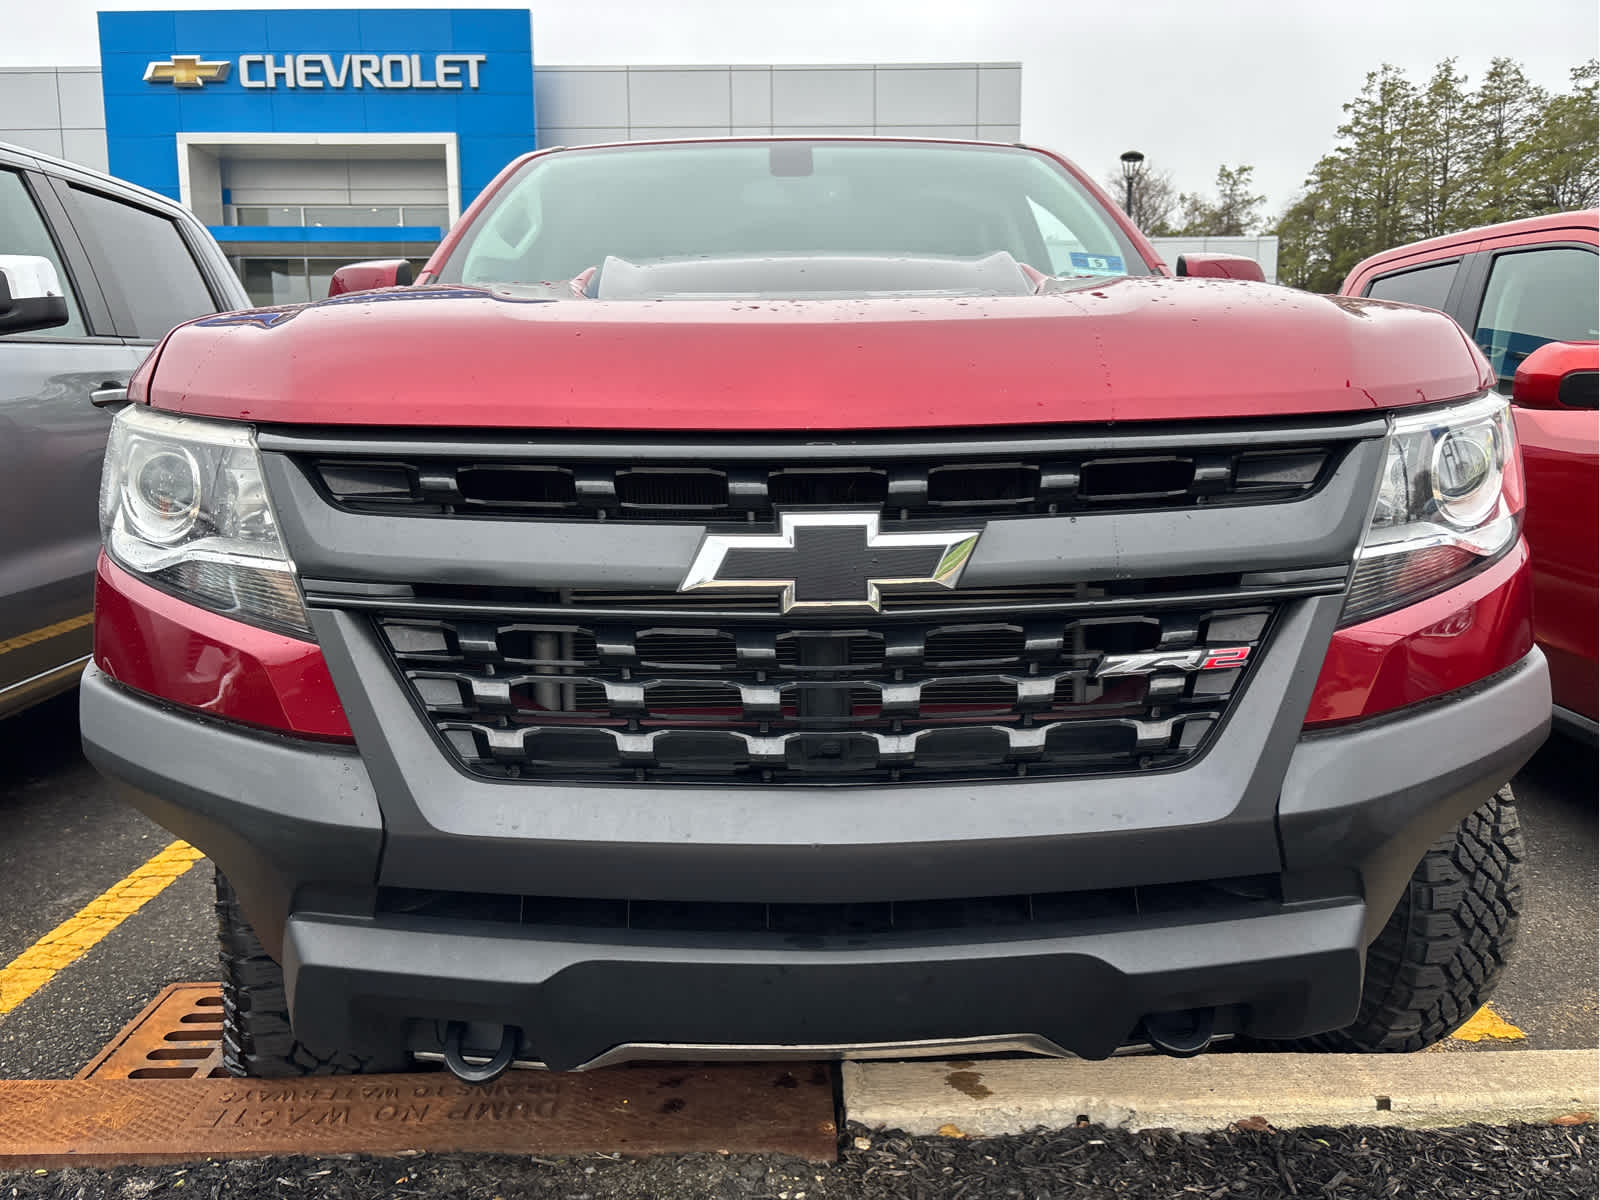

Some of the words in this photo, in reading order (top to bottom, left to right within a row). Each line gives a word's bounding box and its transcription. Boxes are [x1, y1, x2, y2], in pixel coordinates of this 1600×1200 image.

[238, 54, 486, 88] CHEVROLET
[1096, 646, 1251, 677] ZR2
[218, 1087, 400, 1103] WATERWAYS
[413, 1086, 444, 1097] TO
[206, 1107, 349, 1128] WASTE
[375, 1103, 431, 1122] NO
[448, 1102, 558, 1121] DUMP
